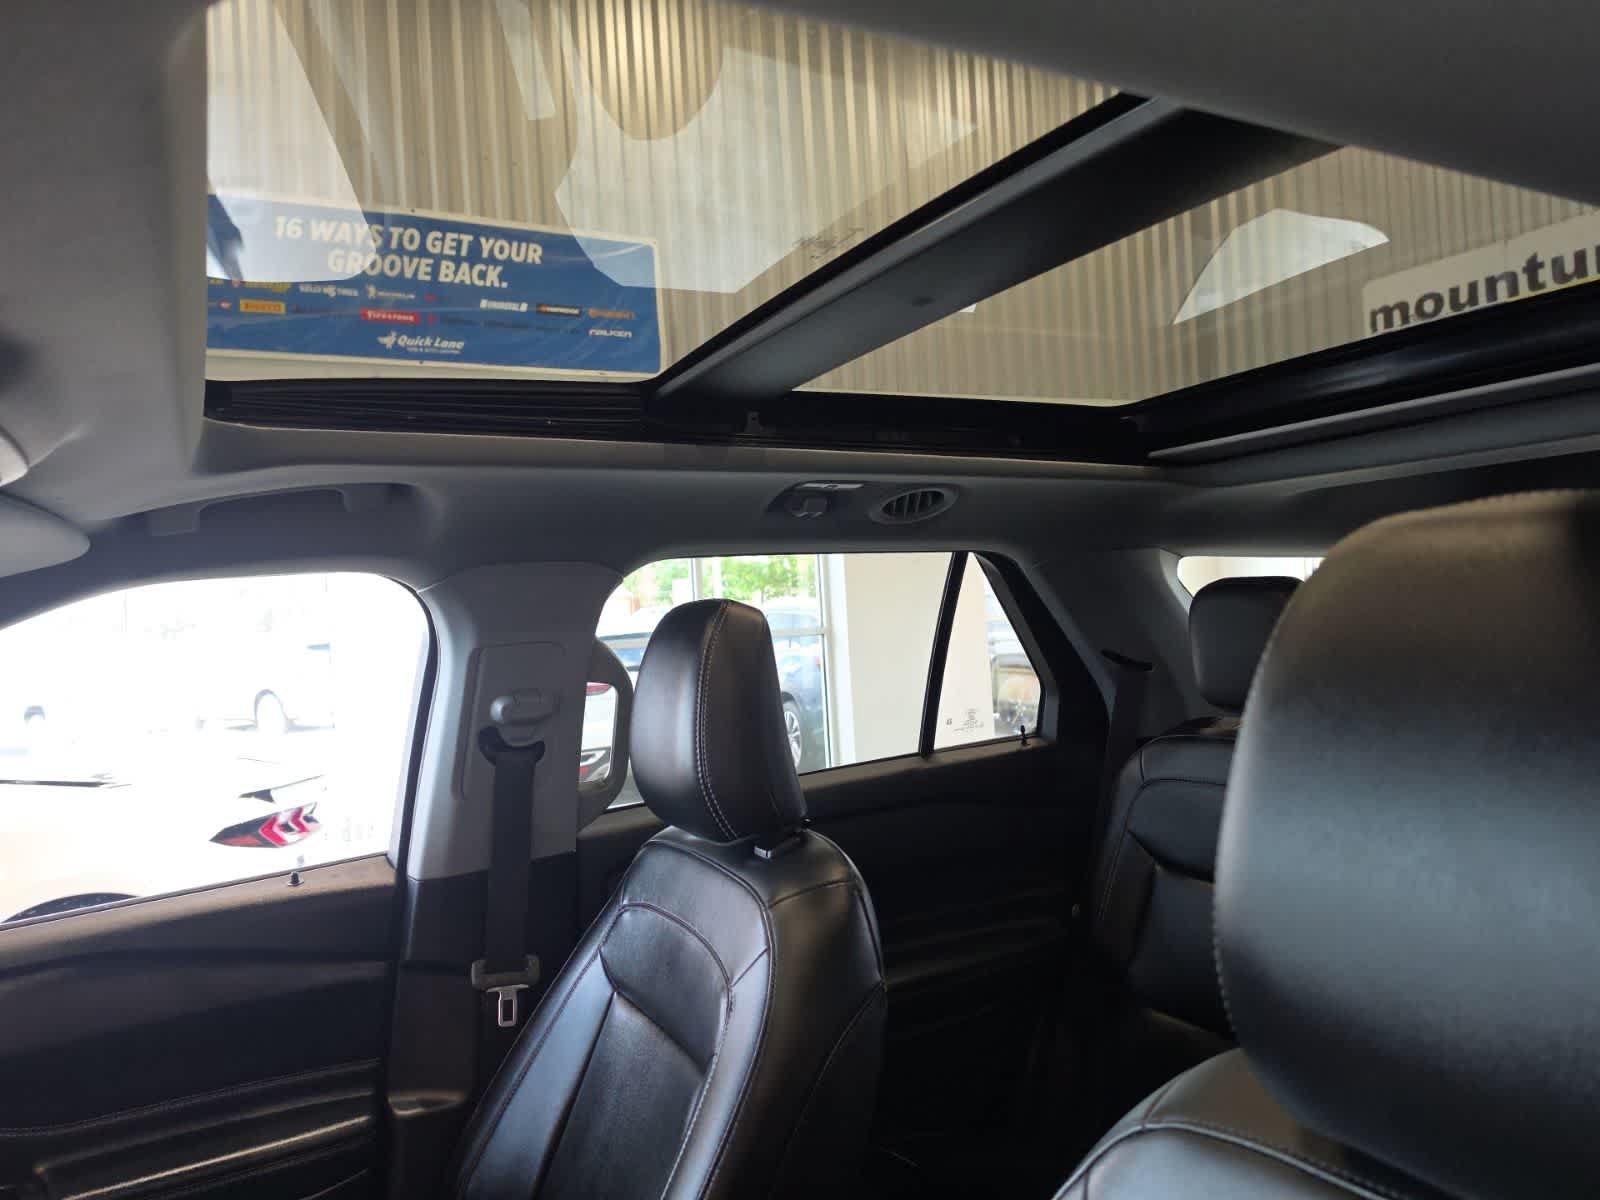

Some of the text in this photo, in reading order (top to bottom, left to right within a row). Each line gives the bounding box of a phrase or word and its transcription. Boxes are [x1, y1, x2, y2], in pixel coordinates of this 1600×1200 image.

[275, 216, 543, 265] 16 WAYS TO GET YOUR
[327, 249, 508, 289] GROOVE BACK.
[1370, 245, 1600, 333] mountu
[397, 334, 433, 347] Quick
[433, 336, 465, 350] Lane
